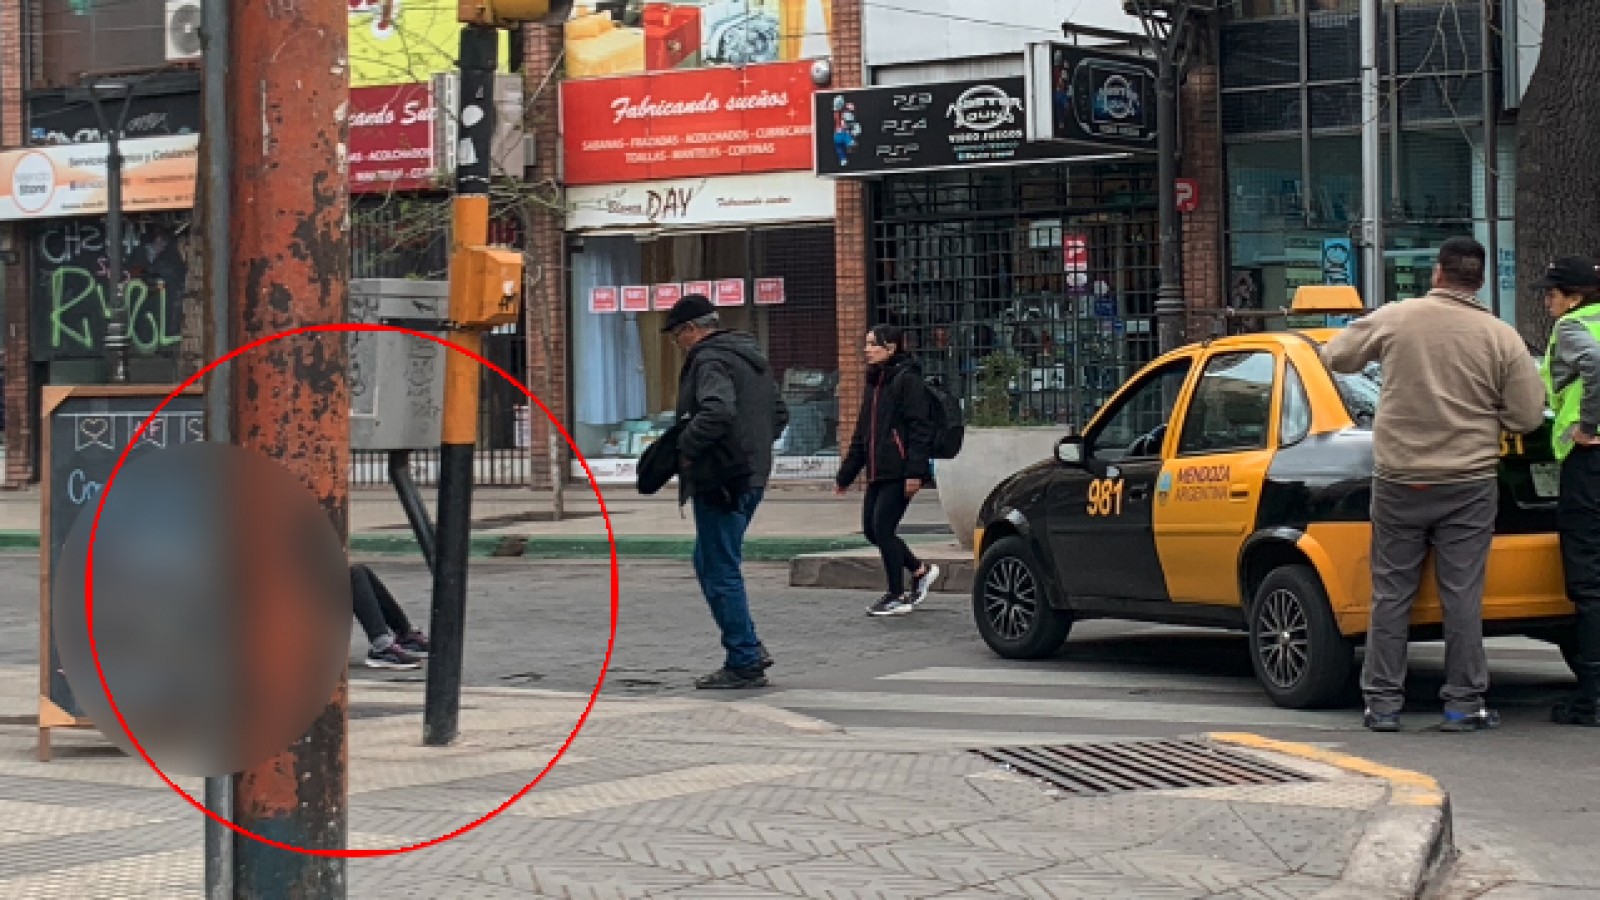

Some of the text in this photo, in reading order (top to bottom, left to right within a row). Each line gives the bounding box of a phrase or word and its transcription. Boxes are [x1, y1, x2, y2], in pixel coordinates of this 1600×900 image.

[611, 94, 719, 124] Fabricando
[646, 187, 695, 222] DAY
[1176, 464, 1231, 484] MENDOZA
[1086, 478, 1124, 517] 981
